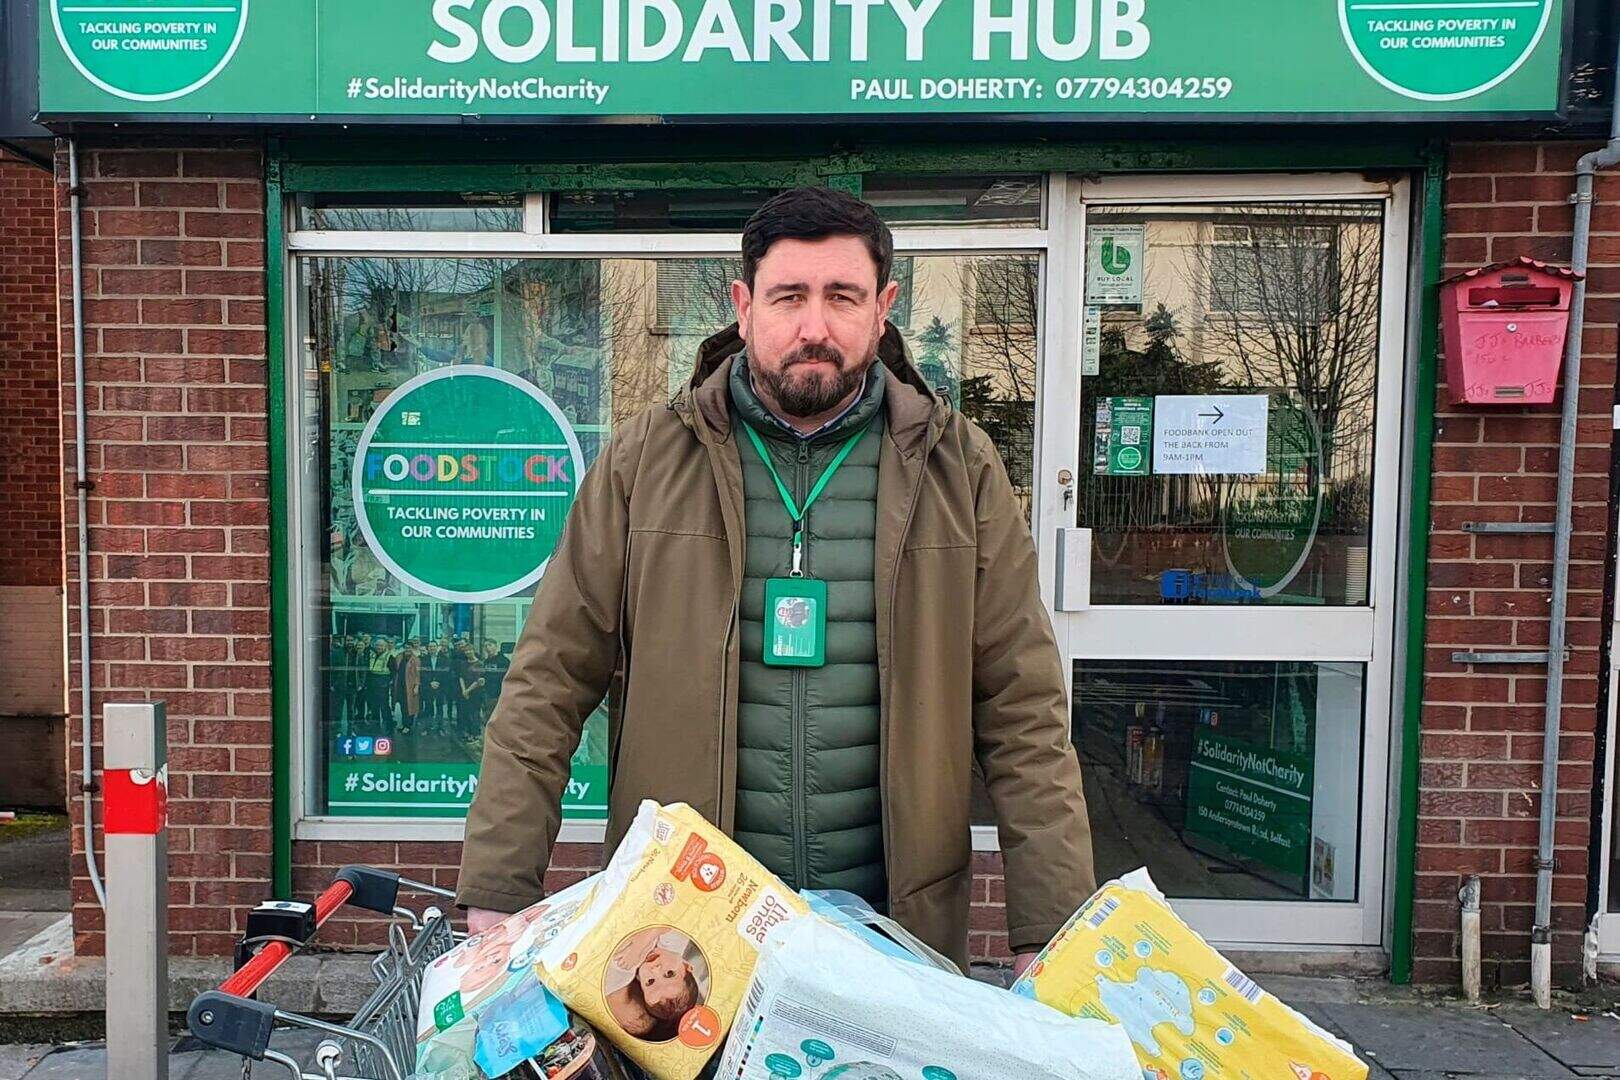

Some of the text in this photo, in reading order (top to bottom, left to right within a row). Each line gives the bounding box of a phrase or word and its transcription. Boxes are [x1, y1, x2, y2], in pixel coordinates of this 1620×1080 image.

[79, 22, 217, 34] TACKLING POVERTY IN
[426, 0, 1151, 63] SOLIDARITY HUB
[1368, 18, 1516, 32] TACKLING POVERTY IN
[92, 39, 208, 50] OUR COMMUNITIES
[1380, 36, 1505, 49] OUR COMMUNITIES
[346, 77, 610, 105] #SolidarityNotCharity
[851, 77, 1233, 100] PAUL DOHERTY: 07794304259
[1163, 428, 1253, 437] FOODBANK OPEN OUT
[1163, 441, 1229, 449] THE BACK FROM
[1162, 453, 1204, 461] 9AM-1PM
[367, 453, 572, 485] FOODSTOCK
[387, 507, 545, 521] TACKLING POVERTY IN
[401, 525, 535, 539] OUR COMMUNITIES
[1198, 739, 1304, 788] #SolidarityNotCharity
[725, 878, 759, 924] Newborn
[745, 894, 776, 936] ones
